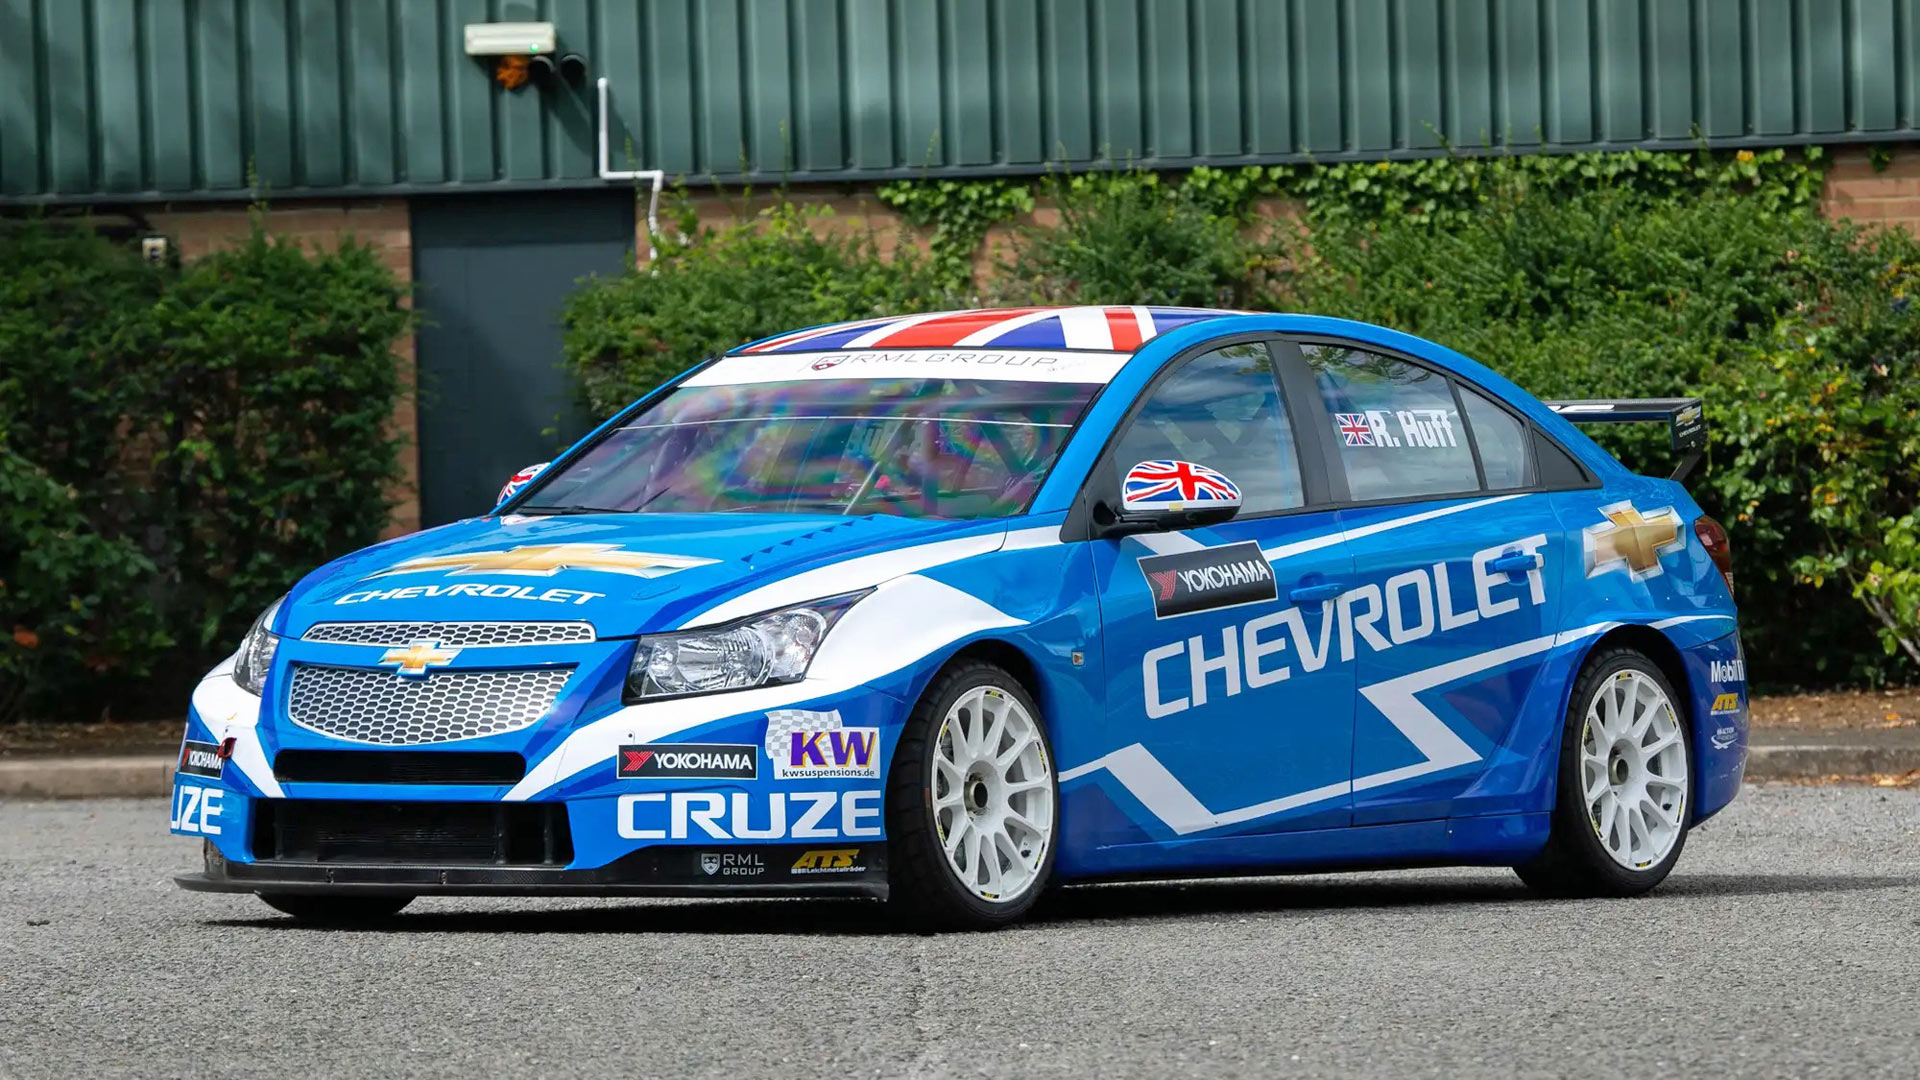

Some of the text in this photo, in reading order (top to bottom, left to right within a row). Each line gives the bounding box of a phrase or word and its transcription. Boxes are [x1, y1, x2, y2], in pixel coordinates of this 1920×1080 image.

[1364, 410, 1457, 447] R. Huff
[1178, 559, 1271, 593] YOKOHAMA
[334, 583, 606, 605] CHEVROLET
[1142, 534, 1548, 720] CHEVROLET
[188, 750, 222, 770] YOKOHAMA
[790, 731, 876, 768] KW
[654, 752, 753, 771] YOKOHAMA
[782, 768, 875, 779] kwsuspensions.de
[617, 790, 881, 839] CRUZE
[723, 853, 764, 866] RML
[791, 849, 860, 869] ATS
[722, 867, 765, 876] GROUP
